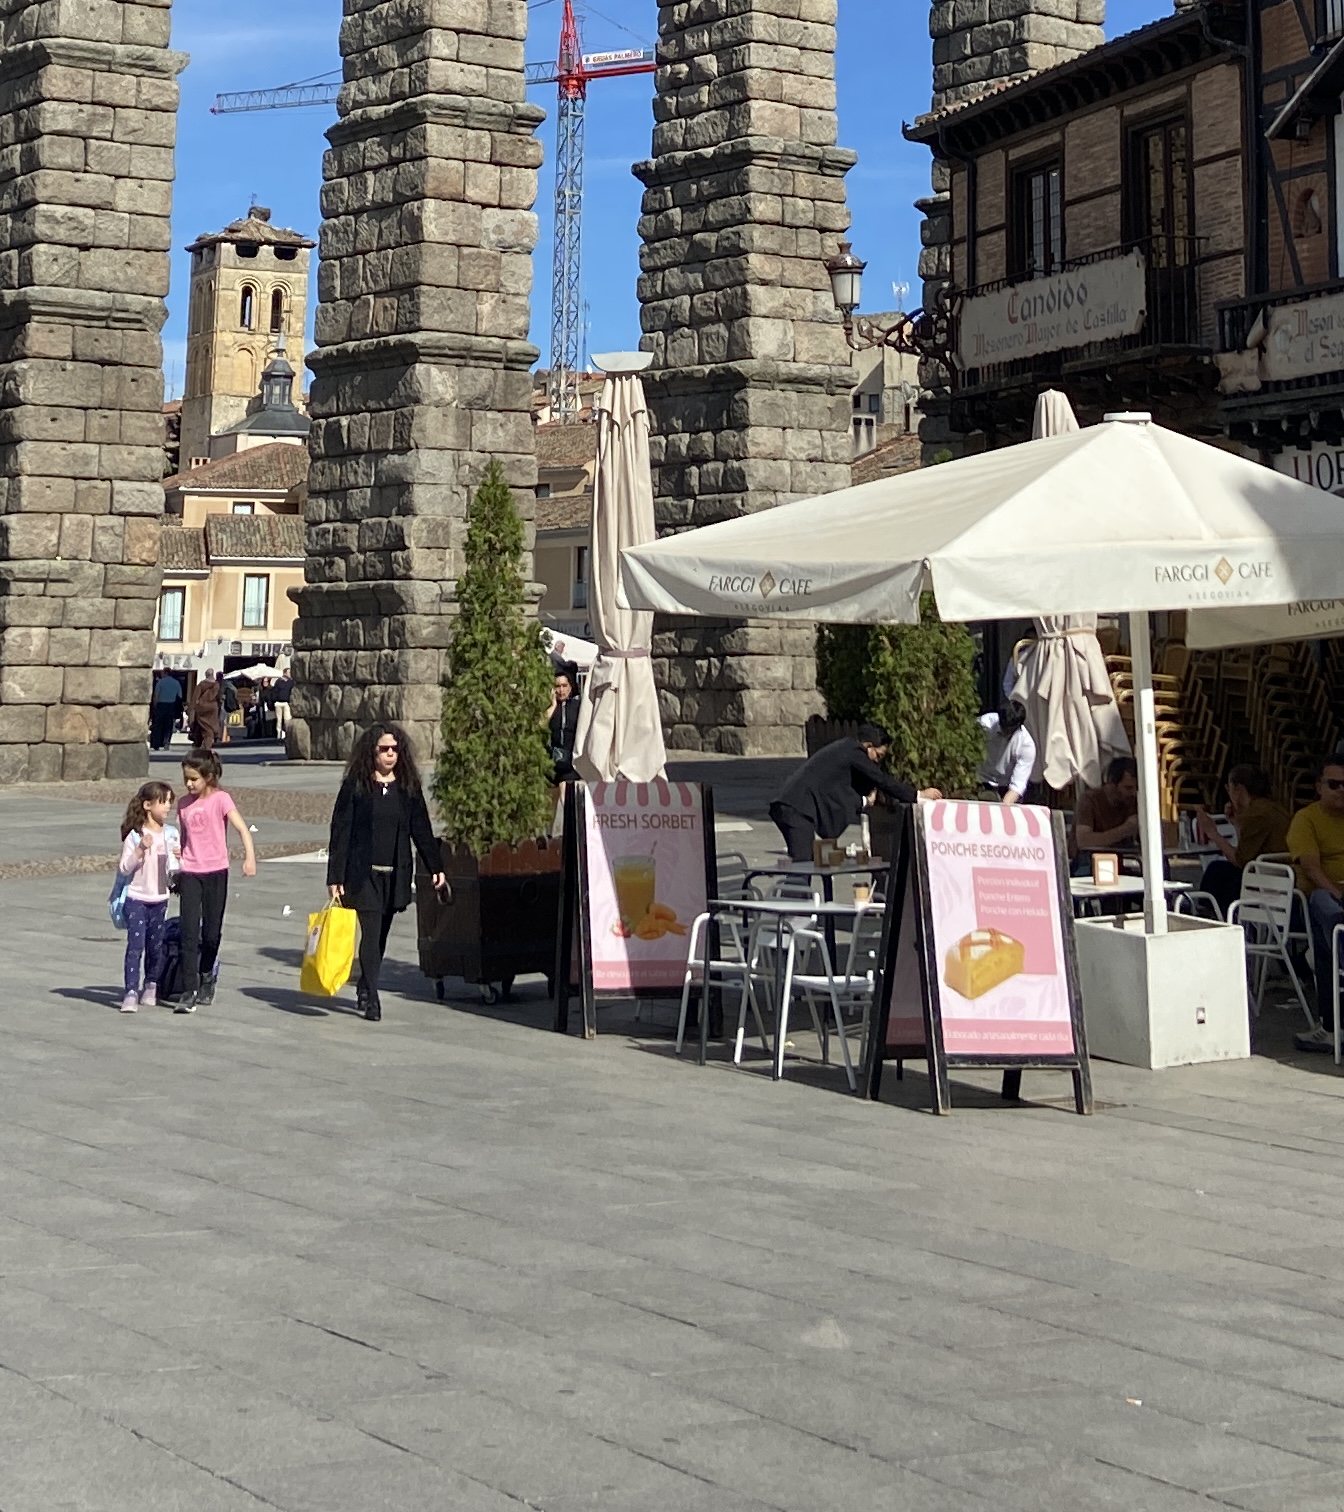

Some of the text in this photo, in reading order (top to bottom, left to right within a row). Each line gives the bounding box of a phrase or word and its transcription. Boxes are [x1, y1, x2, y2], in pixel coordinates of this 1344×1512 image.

[1007, 279, 1088, 324] Candido
[1024, 322, 1061, 347] Mayor
[1066, 318, 1078, 334] de
[1083, 303, 1128, 330] Castilla
[1154, 561, 1273, 584] FARGGI CAFE
[709, 575, 813, 596] FARGGI CAFE
[1195, 590, 1244, 600] SEGOVIA
[593, 813, 696, 830] FRESH SORBET
[930, 841, 1046, 861] PONCHE SEGOVIANO
